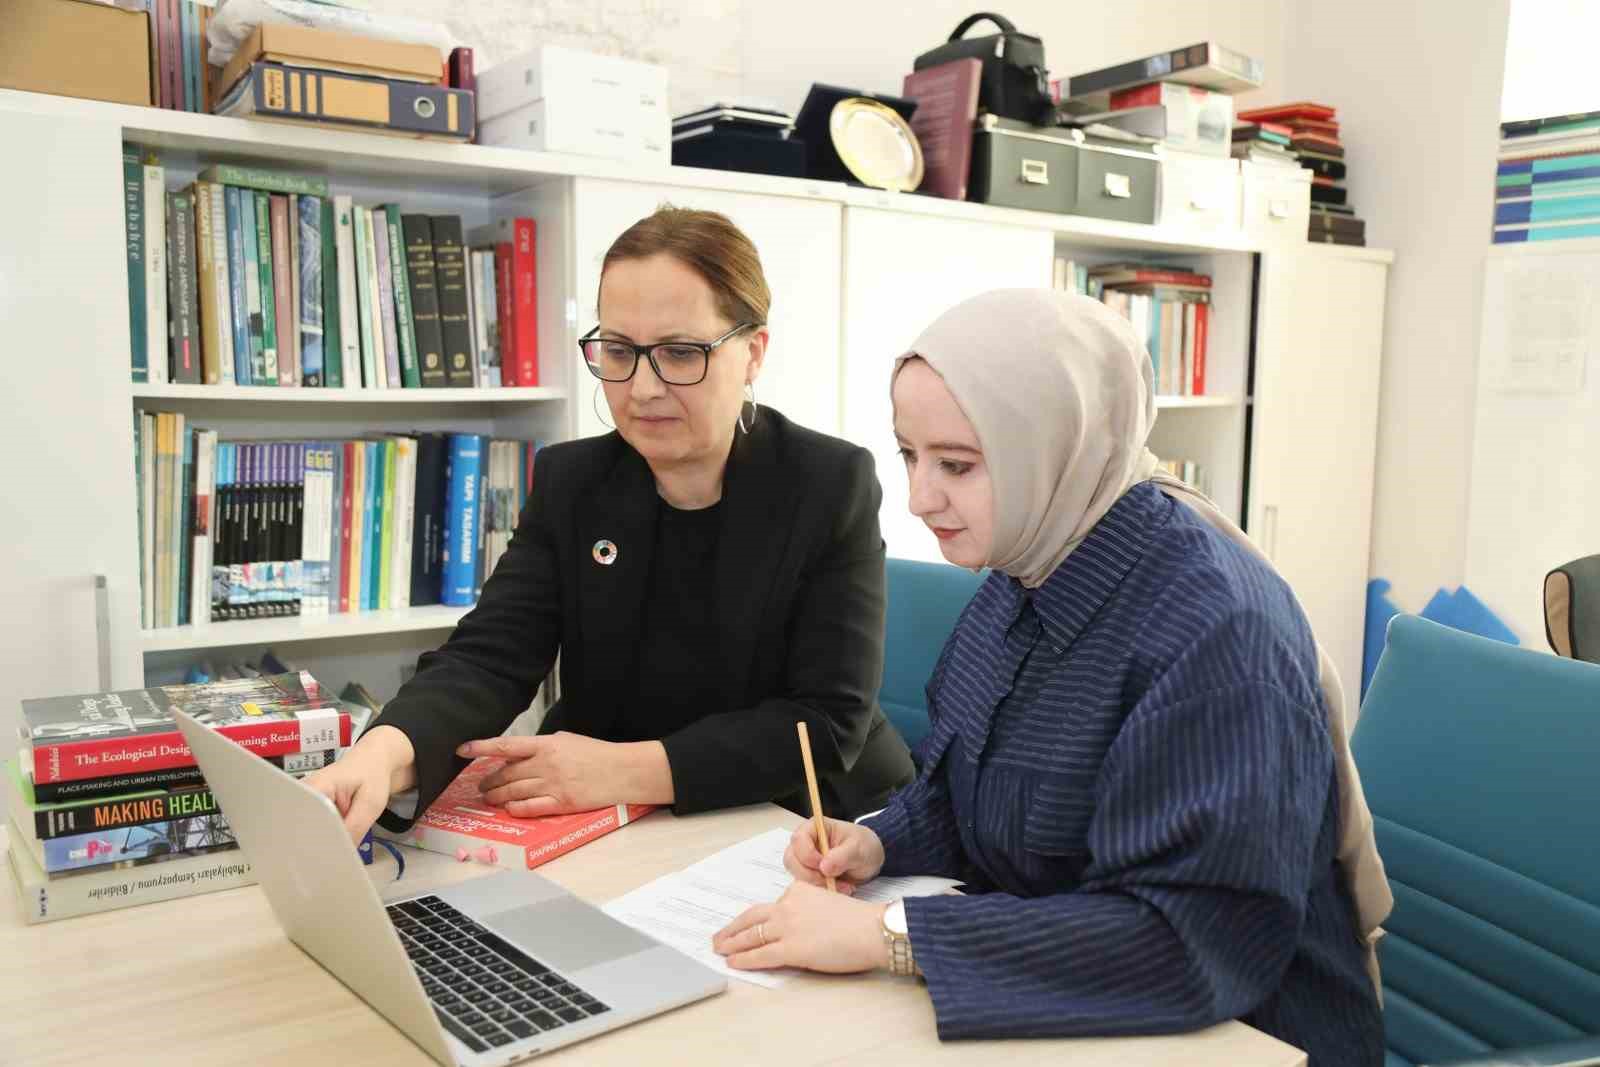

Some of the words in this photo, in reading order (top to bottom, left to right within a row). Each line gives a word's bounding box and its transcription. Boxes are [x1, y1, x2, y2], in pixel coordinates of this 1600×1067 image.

[127, 181, 142, 262] Hasbahçe
[270, 730, 300, 743] Reade
[74, 753, 98, 766] The
[102, 745, 157, 763] Ecological
[160, 743, 192, 757] Desig
[113, 776, 129, 787] AND
[130, 774, 157, 785] URBAN
[158, 769, 202, 782] DEVELOPMEN
[94, 798, 164, 827] MAKING
[169, 790, 216, 816] HEALT
